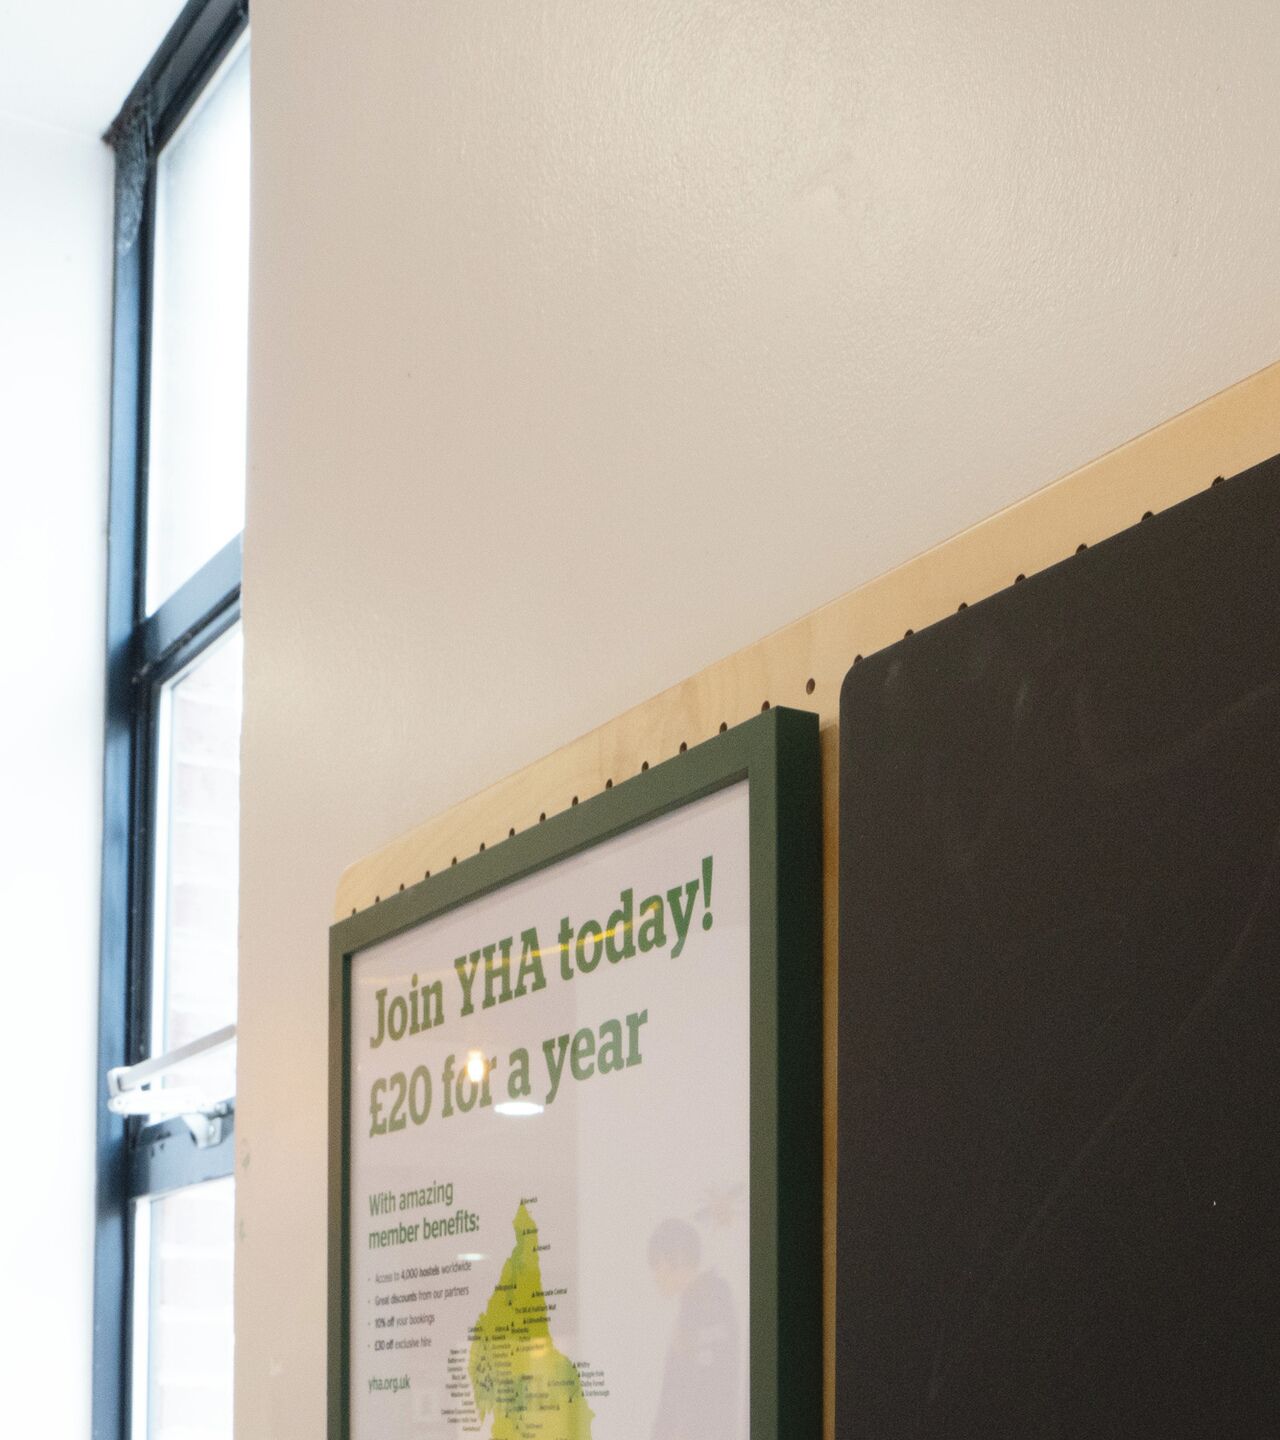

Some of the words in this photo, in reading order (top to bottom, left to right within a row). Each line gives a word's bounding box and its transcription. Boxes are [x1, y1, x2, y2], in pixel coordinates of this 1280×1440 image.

[370, 973, 445, 1049] Join
[454, 926, 547, 1018] YHA
[558, 855, 713, 981] today!
[370, 1065, 432, 1138] £20
[441, 1054, 497, 1119] for
[507, 1047, 531, 1099] a
[542, 1009, 648, 1105] year
[369, 1191, 396, 1216] With
[400, 1180, 454, 1213] amazing
[369, 1222, 420, 1249] member
[423, 1209, 480, 1240] benefits:
[420, 1265, 440, 1277] hostels
[441, 1262, 472, 1274] worldwide
[391, 1292, 417, 1304] discounts
[419, 1290, 432, 1300] from
[433, 1290, 443, 1299] our
[445, 1286, 469, 1300] partners
[410, 1313, 435, 1326] bookings
[368, 1374, 410, 1393] yha.org.uk
